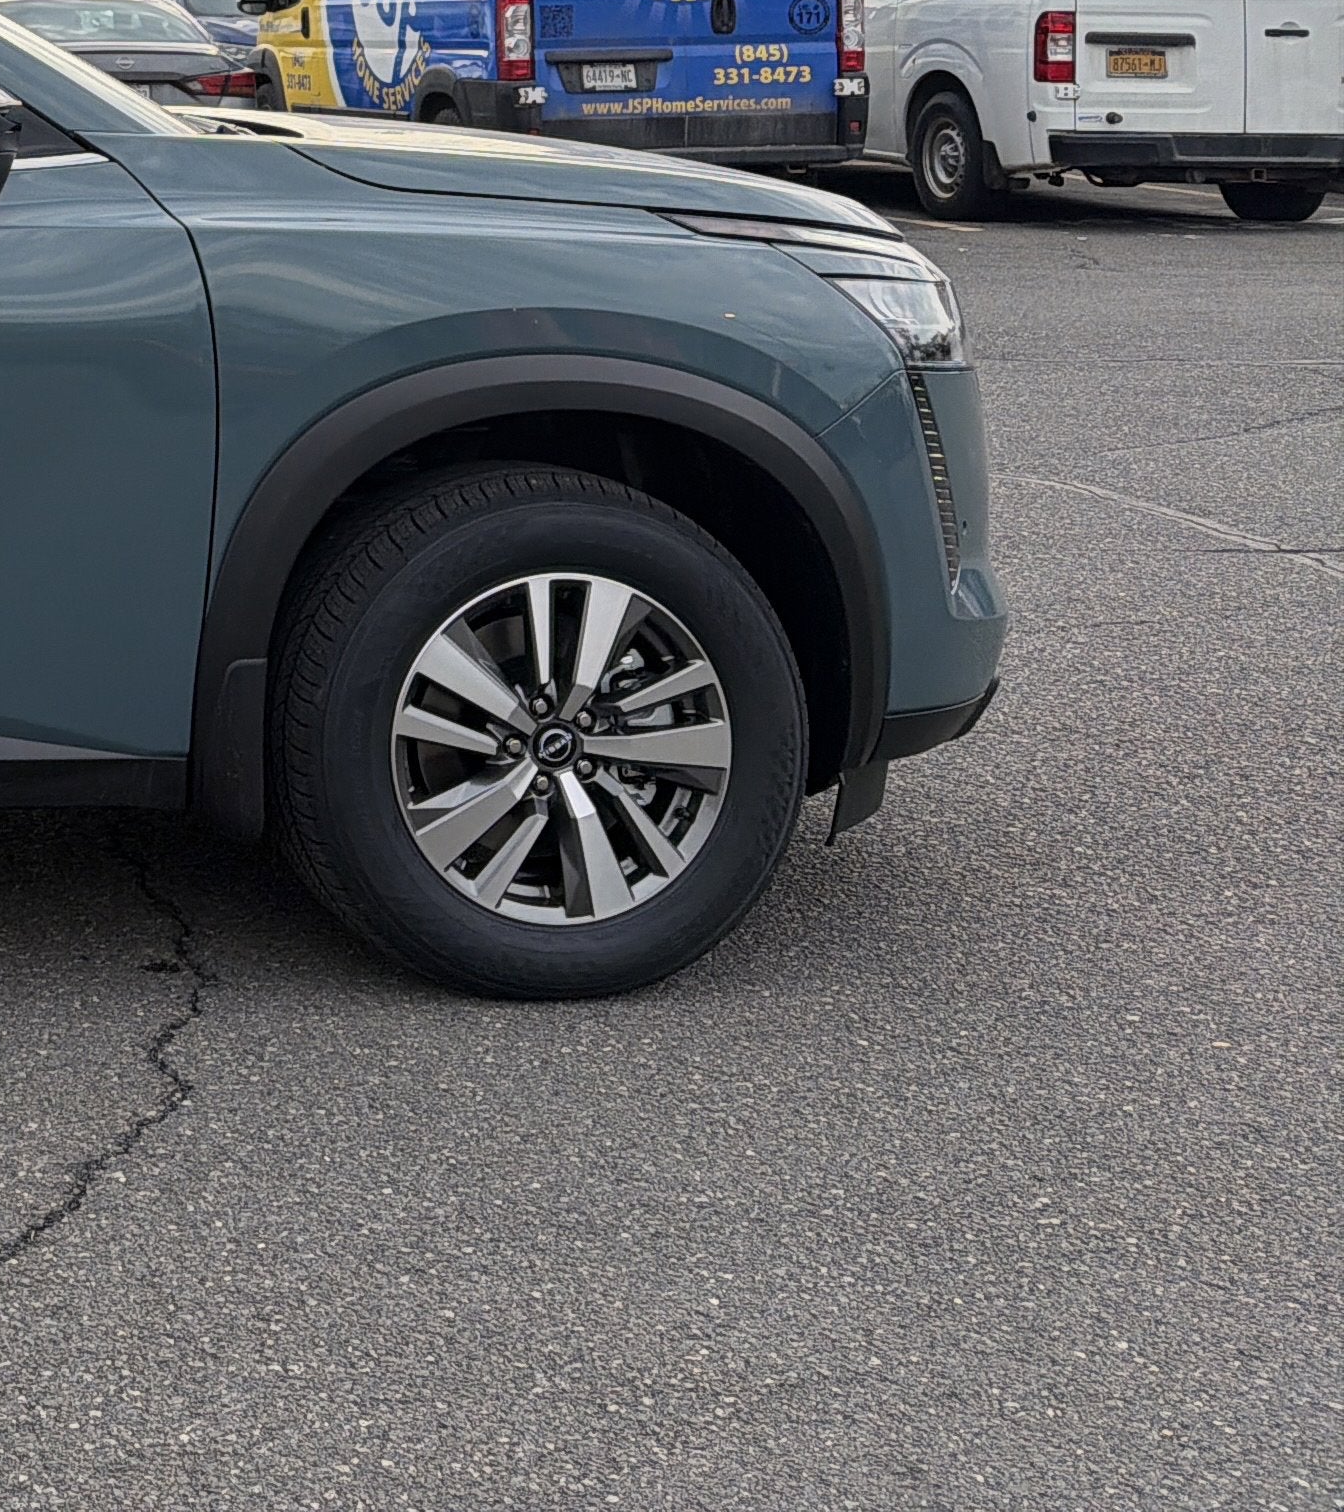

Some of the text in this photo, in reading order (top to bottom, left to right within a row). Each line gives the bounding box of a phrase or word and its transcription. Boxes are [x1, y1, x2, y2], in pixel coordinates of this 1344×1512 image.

[797, 11, 821, 24] 171
[735, 44, 788, 64] (845)
[352, 37, 380, 104] HOME
[714, 66, 812, 86] 331-8473
[582, 95, 792, 116] www.JSPHomeServices.com
